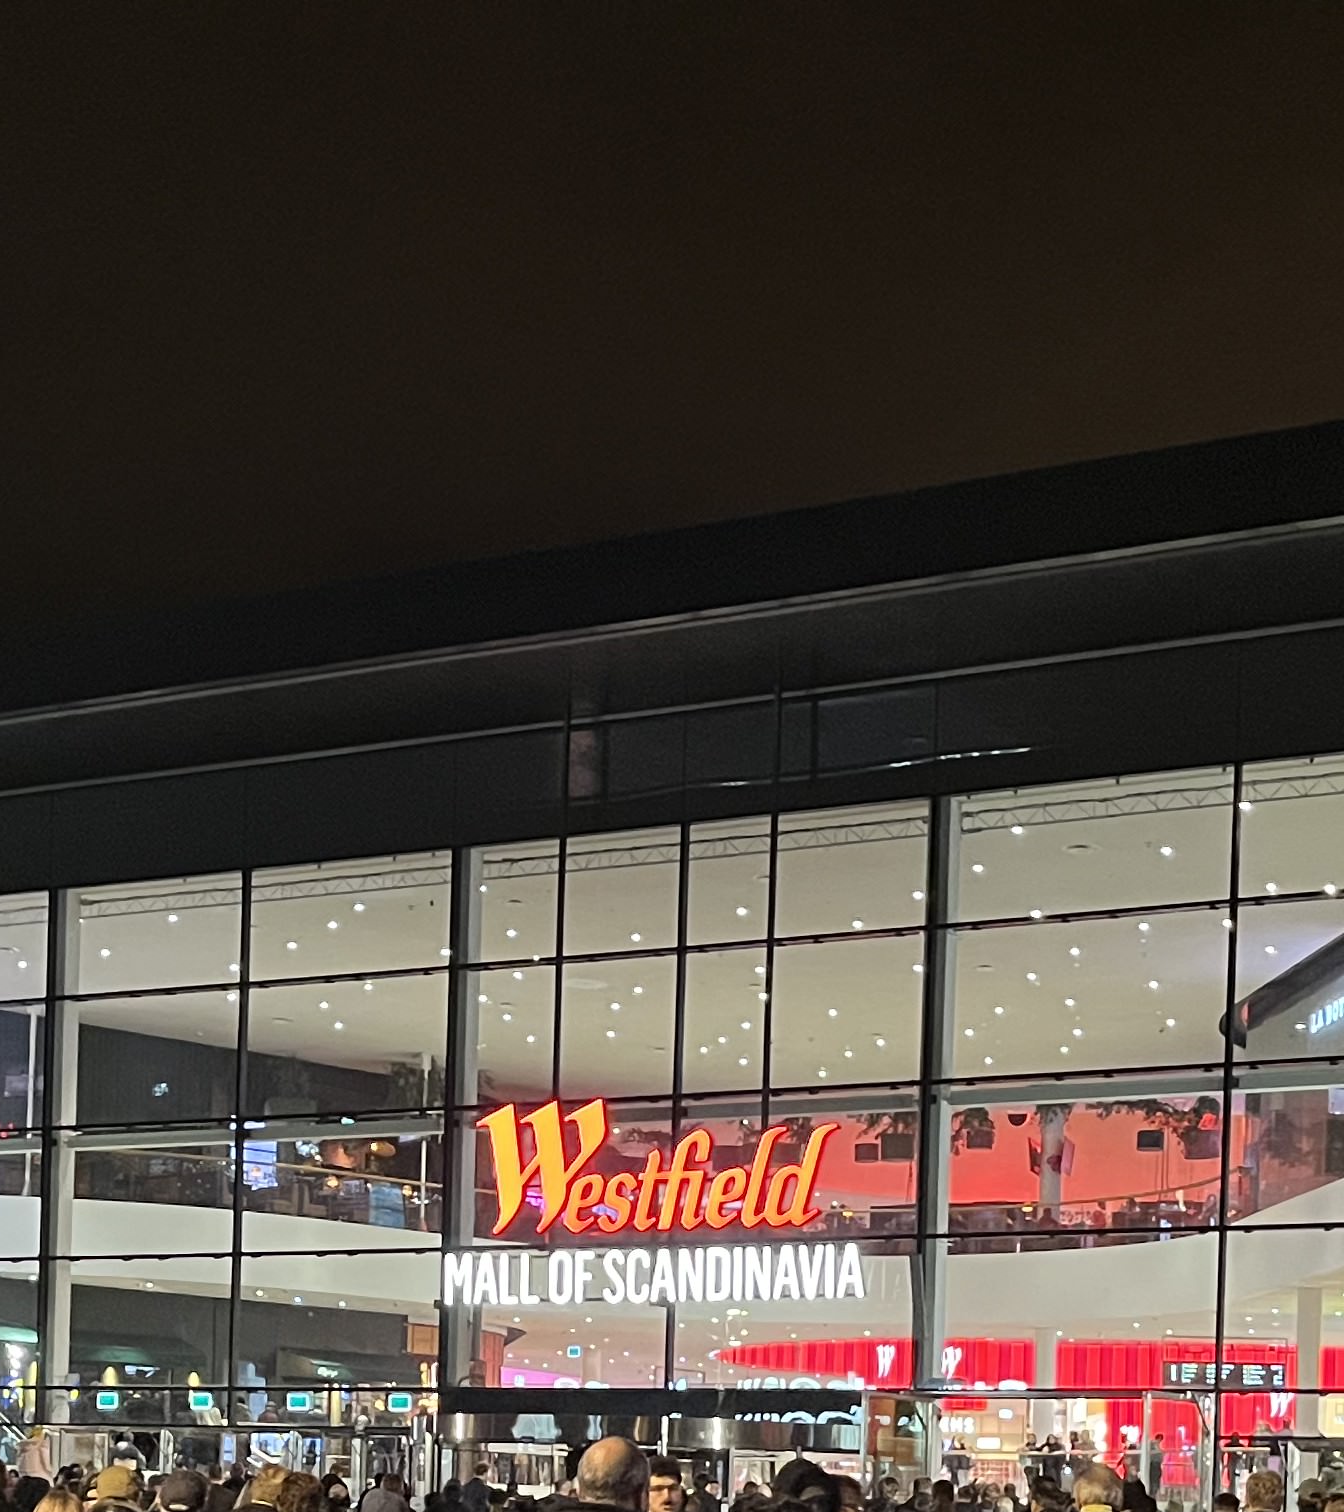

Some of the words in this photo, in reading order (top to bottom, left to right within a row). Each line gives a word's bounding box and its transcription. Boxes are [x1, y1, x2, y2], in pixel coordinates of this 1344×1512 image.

[475, 1097, 843, 1235] Westfield
[443, 1251, 541, 1306] MALL
[548, 1249, 596, 1305] OF
[602, 1242, 867, 1304] SCANDINAVIA
